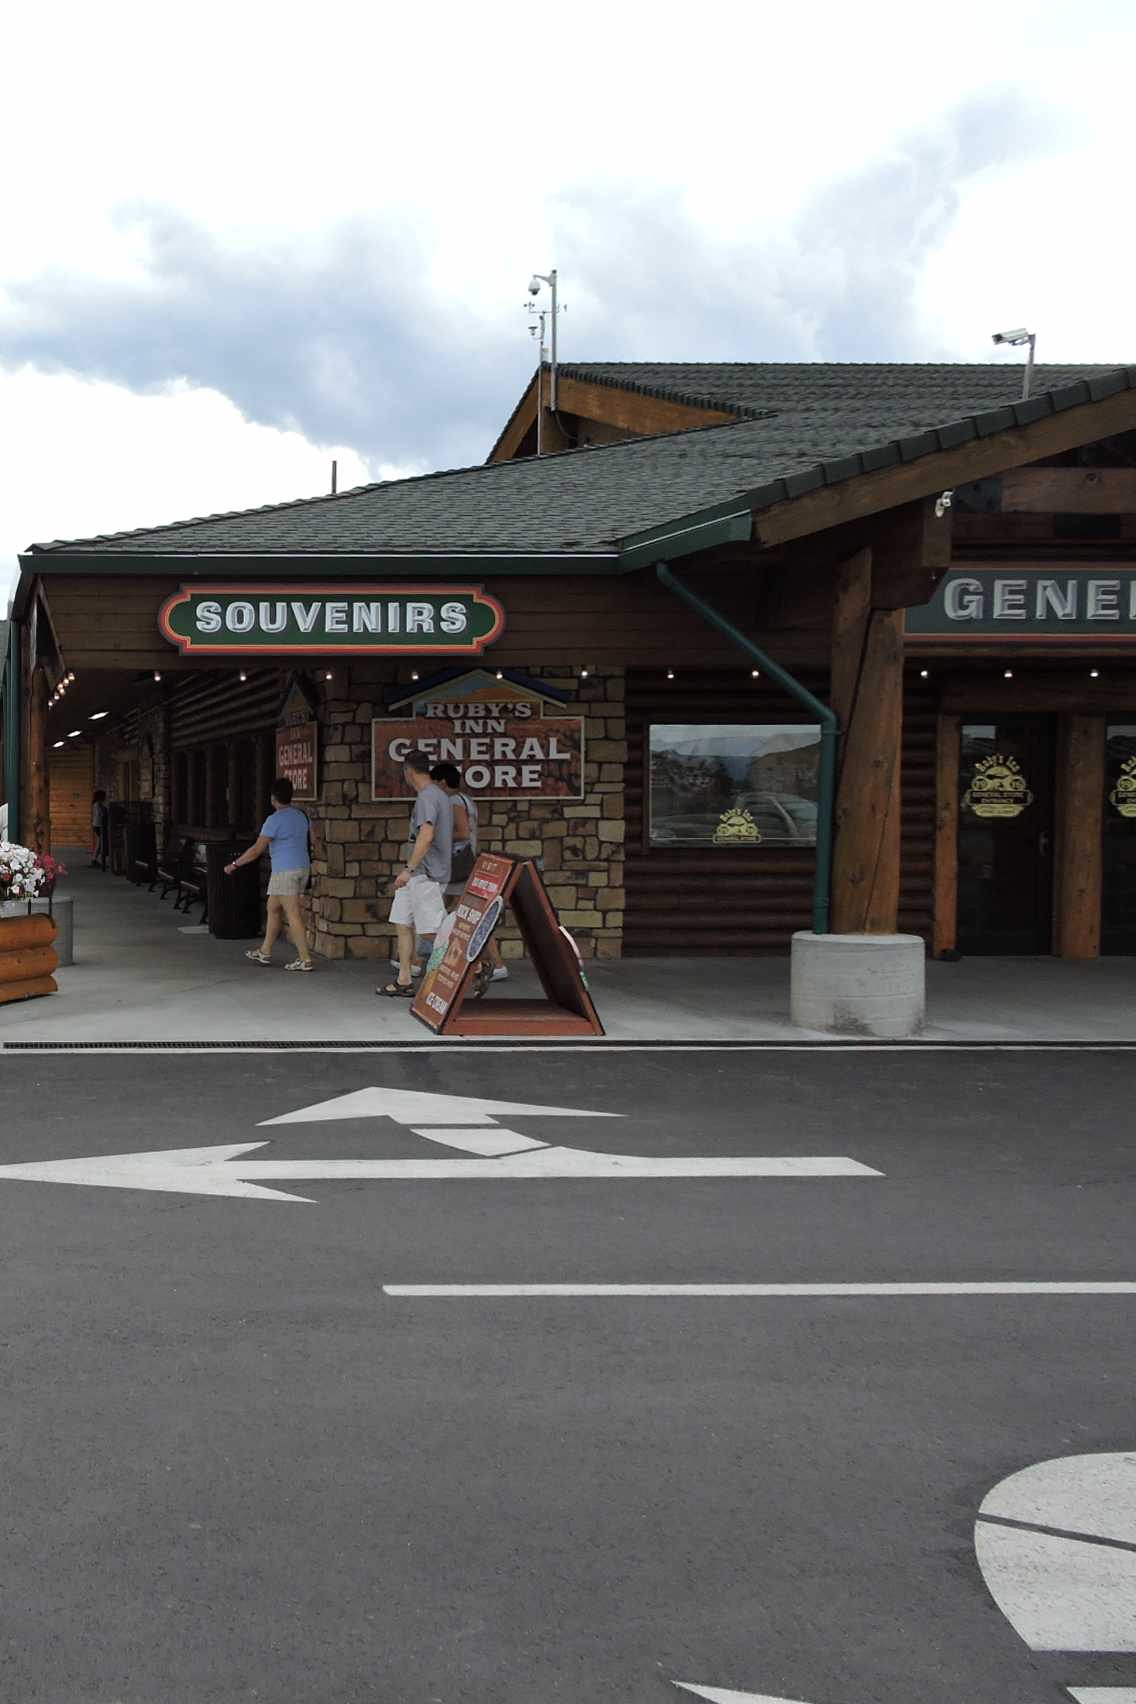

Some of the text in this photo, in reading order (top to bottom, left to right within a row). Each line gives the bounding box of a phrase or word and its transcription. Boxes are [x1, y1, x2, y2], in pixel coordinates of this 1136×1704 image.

[943, 577, 1136, 621] GENE
[195, 601, 467, 634] SOUVENIRS
[425, 702, 532, 718] RUBY'S
[452, 718, 506, 733] INN
[279, 742, 313, 766] GENERAL
[388, 736, 571, 763] GENERAL
[428, 764, 542, 789] ORE
